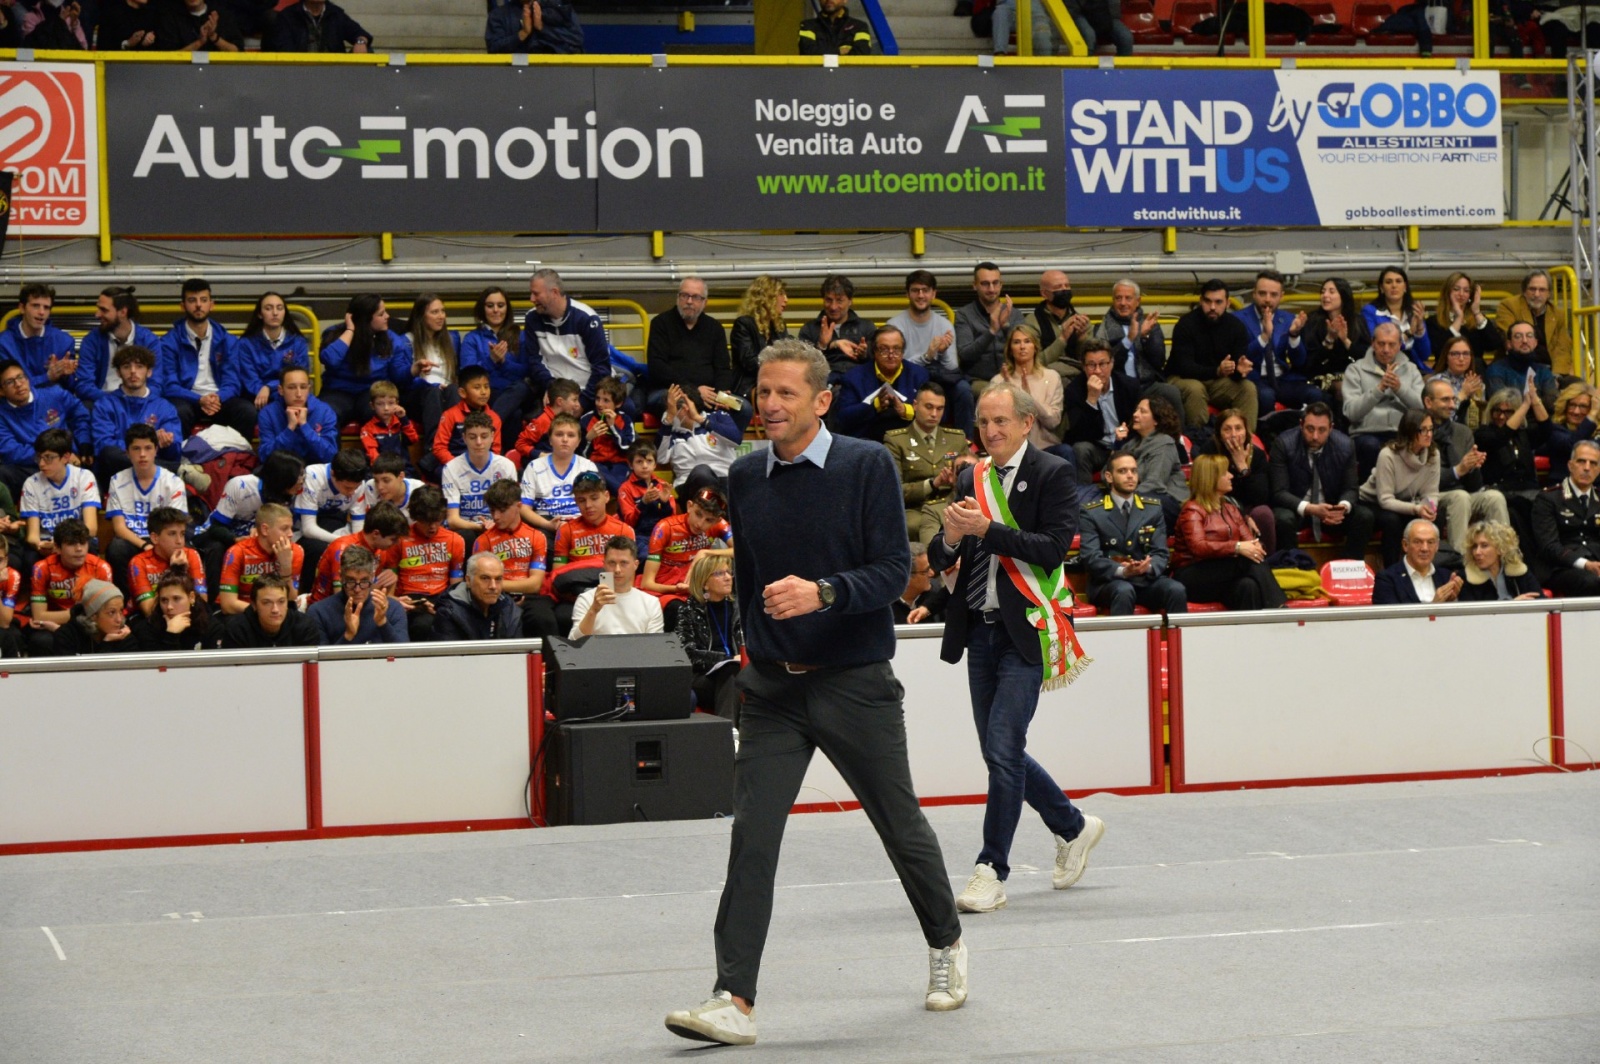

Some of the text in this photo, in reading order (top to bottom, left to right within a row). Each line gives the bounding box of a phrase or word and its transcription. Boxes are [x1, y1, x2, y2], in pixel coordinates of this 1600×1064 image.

[755, 99, 895, 127] Noleggio e
[1267, 82, 1497, 142] by GOBBO
[1070, 99, 1253, 145] STAND
[756, 132, 922, 155] Vendita Auto
[1342, 136, 1472, 148] ALLESTIMENTI
[1318, 152, 1497, 163] YOUR EXHIBITION PARTNER
[757, 167, 1046, 194] www.autoemotion.it
[1133, 207, 1241, 220] standwithus.it
[1345, 206, 1496, 220] gobboallestimenti.com
[552, 484, 573, 497] 69
[51, 495, 70, 510] 38
[405, 541, 448, 557] BUSTESE
